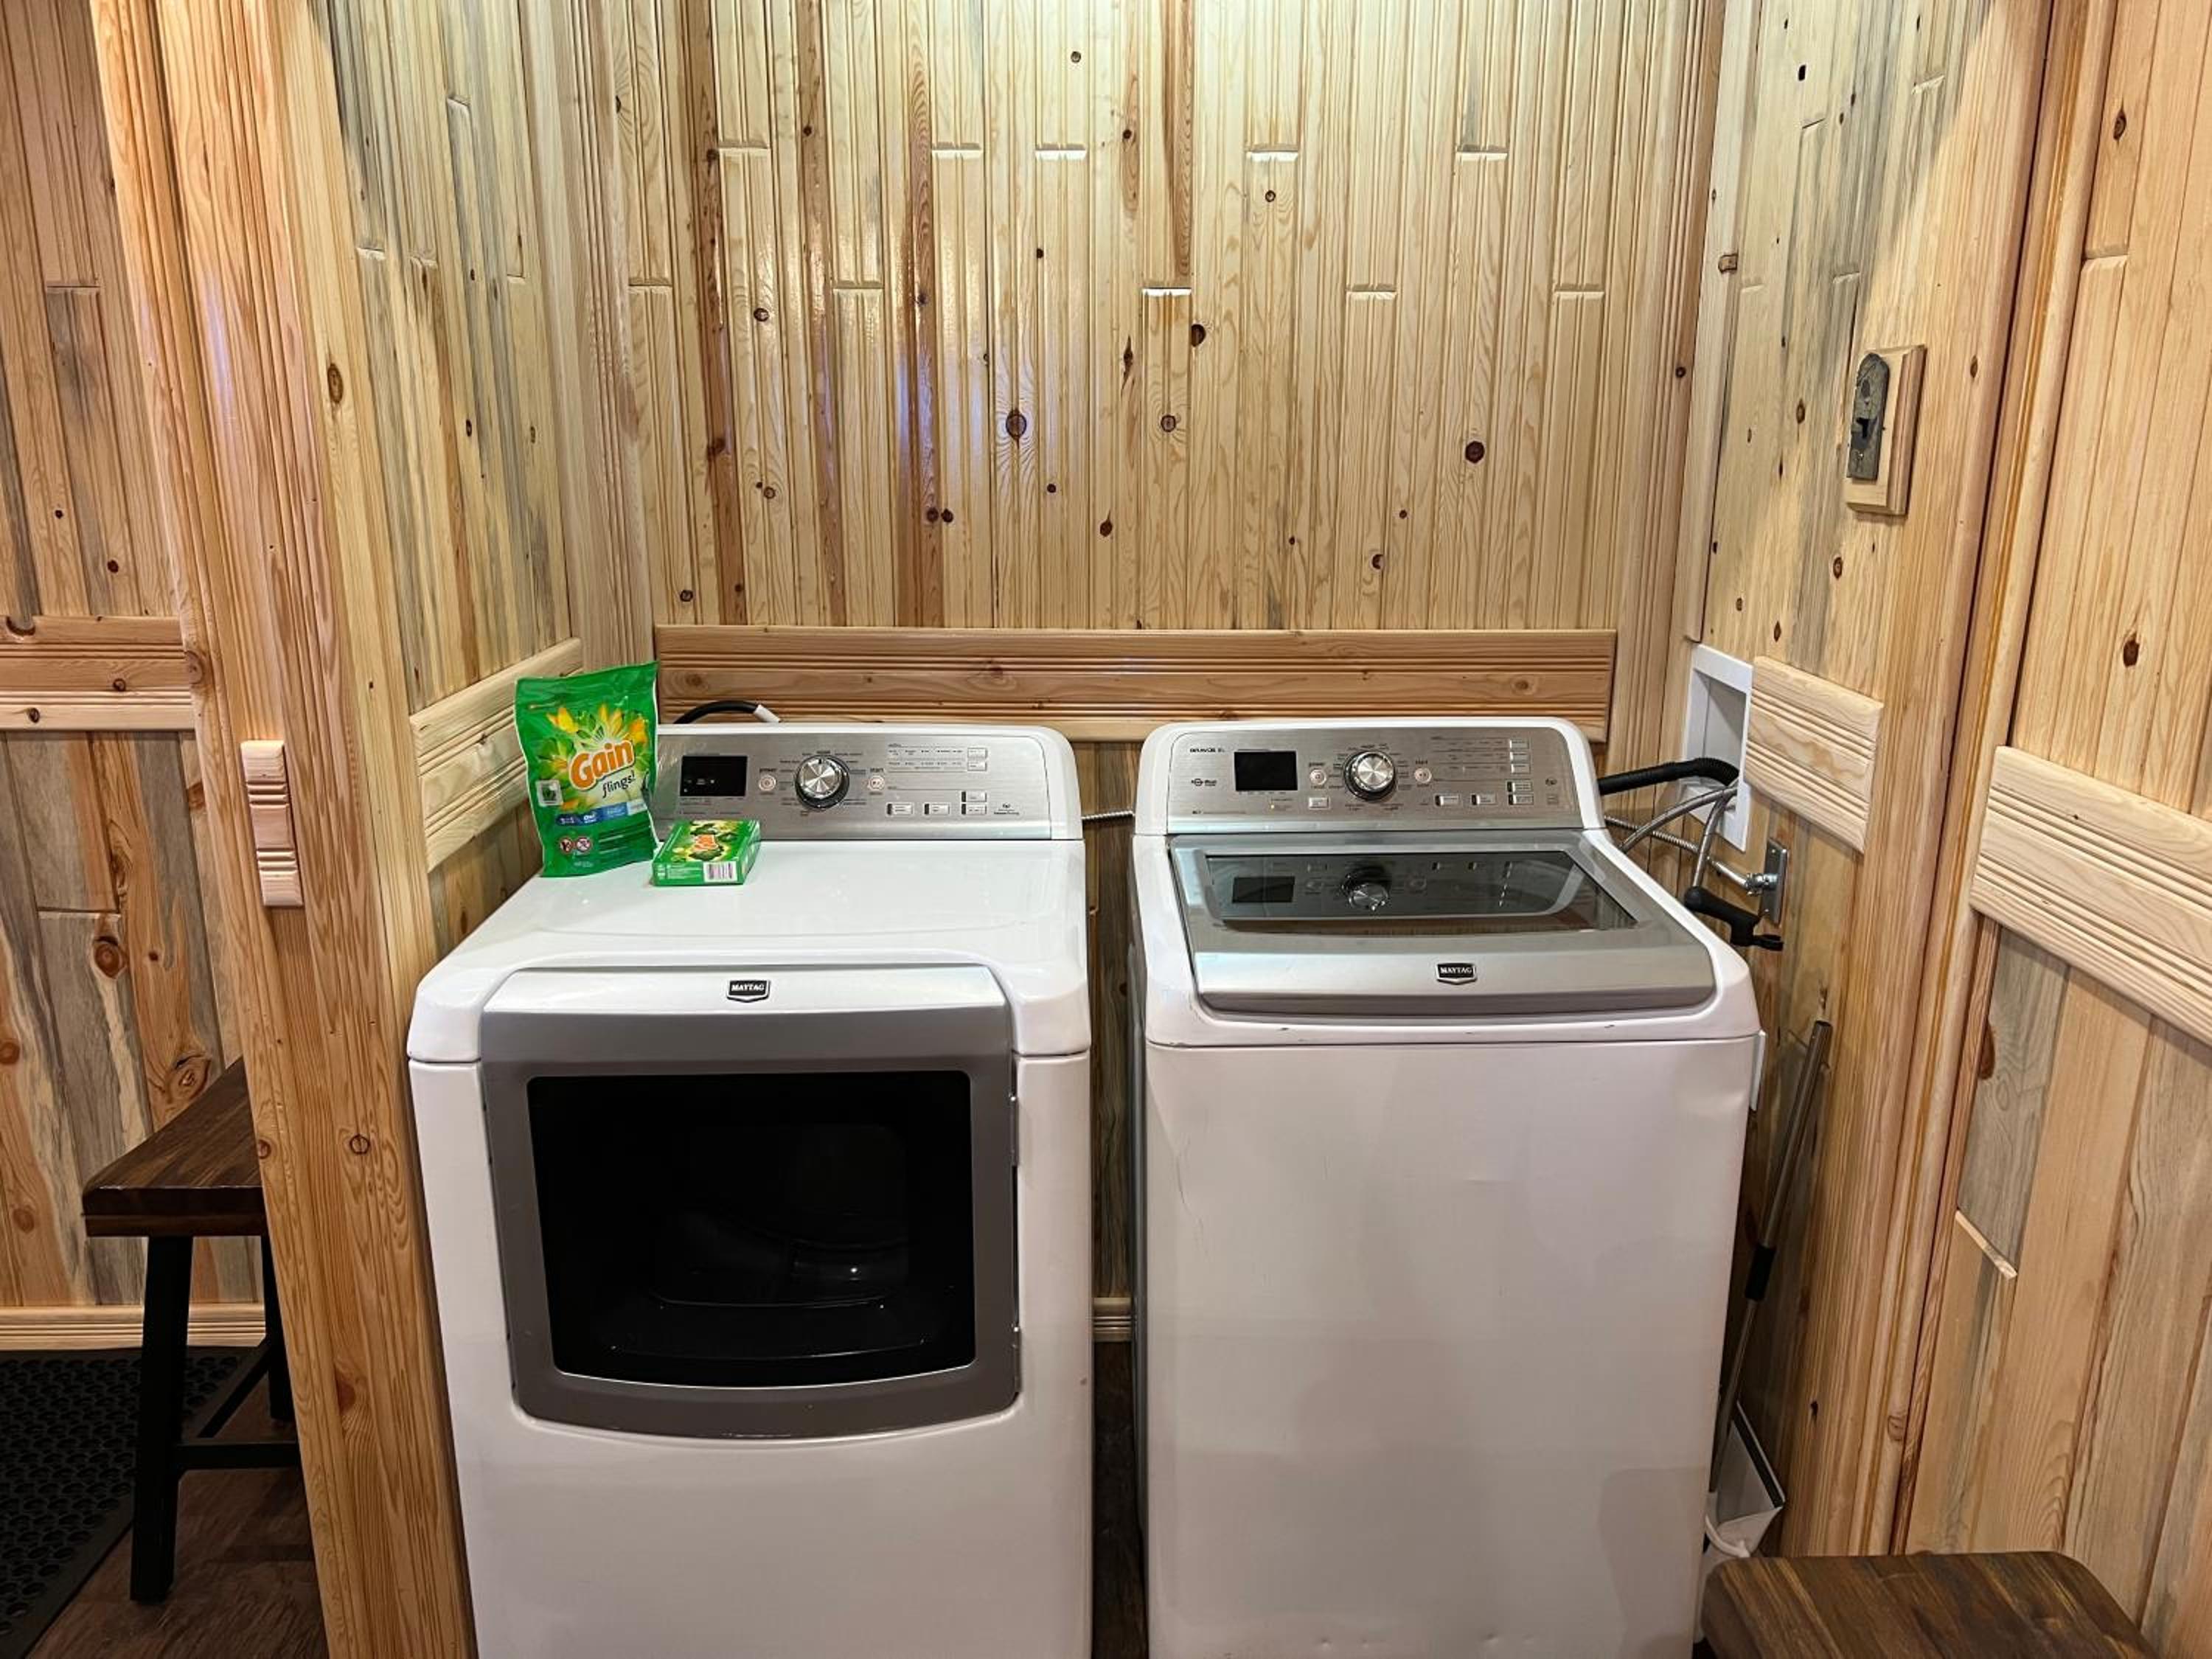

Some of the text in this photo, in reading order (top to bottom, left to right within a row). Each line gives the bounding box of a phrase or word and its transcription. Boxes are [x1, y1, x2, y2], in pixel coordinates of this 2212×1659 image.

[570, 741, 634, 790] Gain
[602, 770, 636, 799] flings!
[731, 983, 765, 992] MAYTAG
